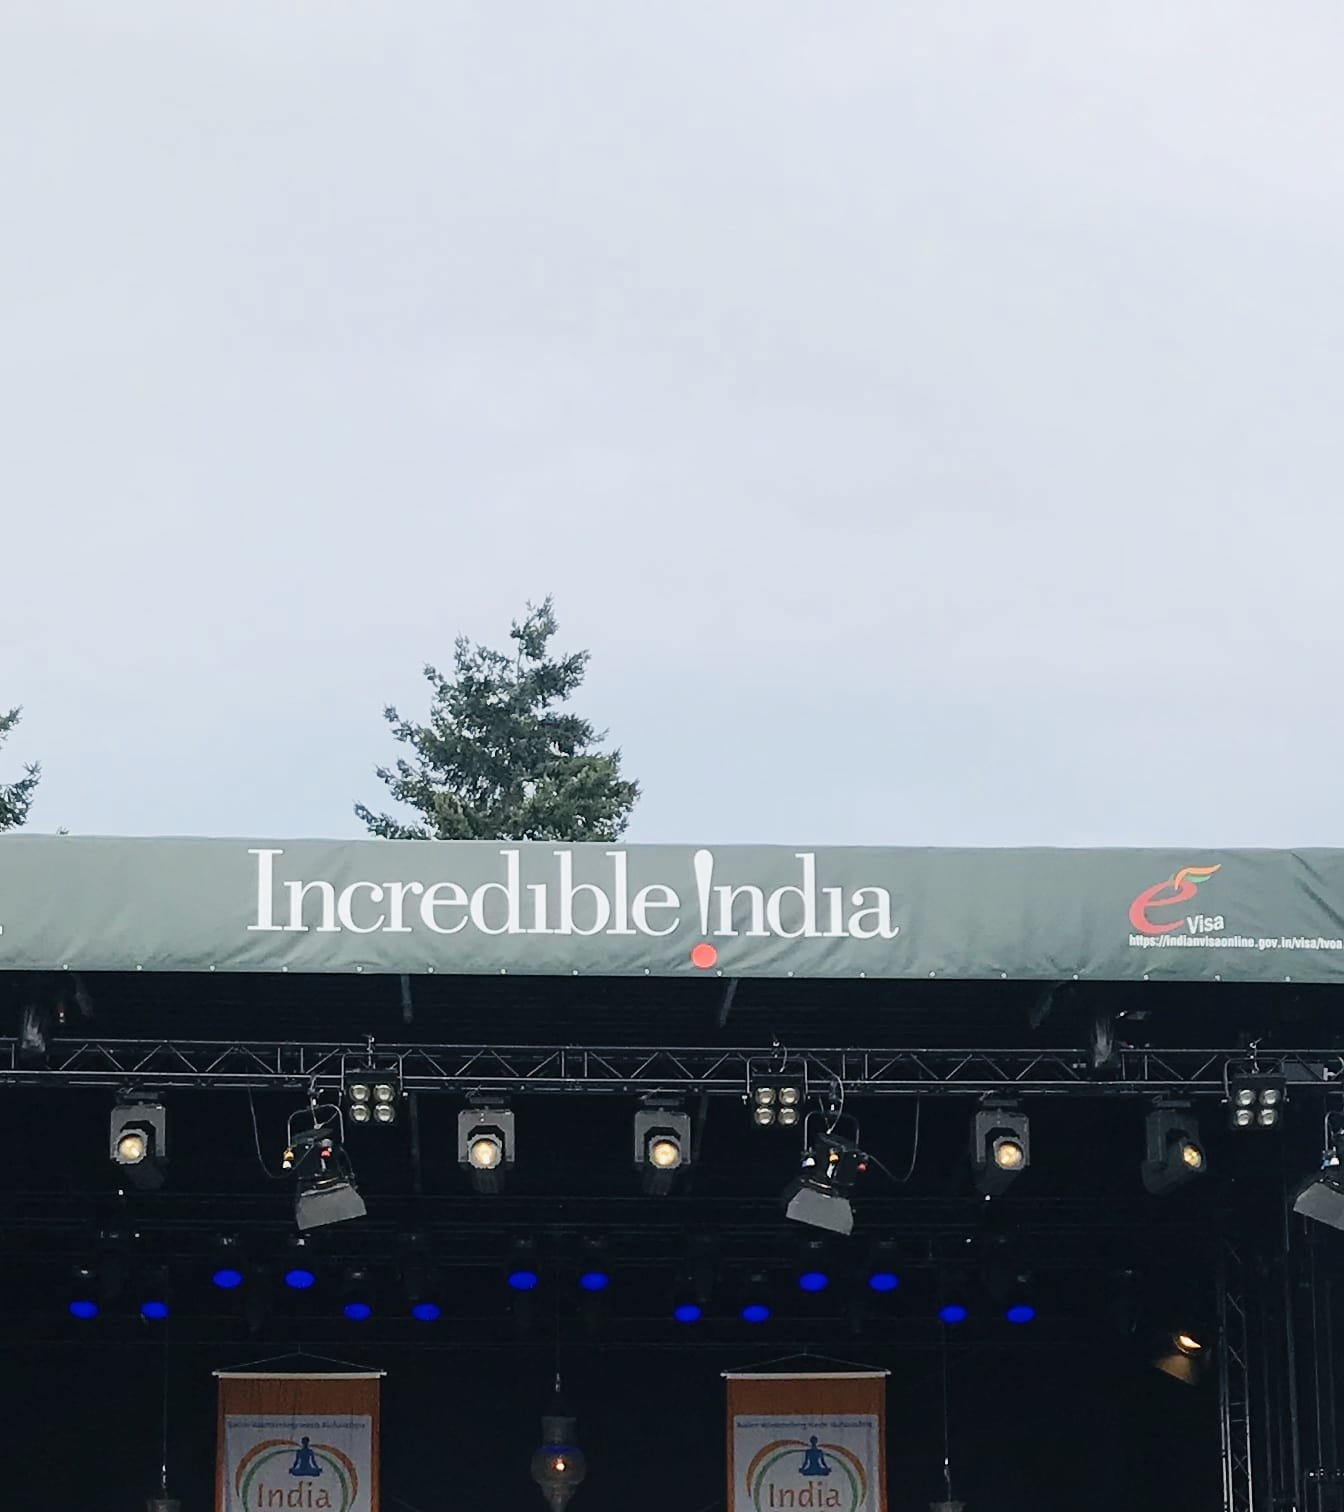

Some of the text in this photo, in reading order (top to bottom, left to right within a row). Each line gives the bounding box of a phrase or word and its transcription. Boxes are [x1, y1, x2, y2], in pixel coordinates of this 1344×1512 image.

[248, 847, 680, 936] Incredible
[1187, 915, 1224, 934] Visa
[257, 1481, 332, 1508] India
[769, 1481, 842, 1508] India
